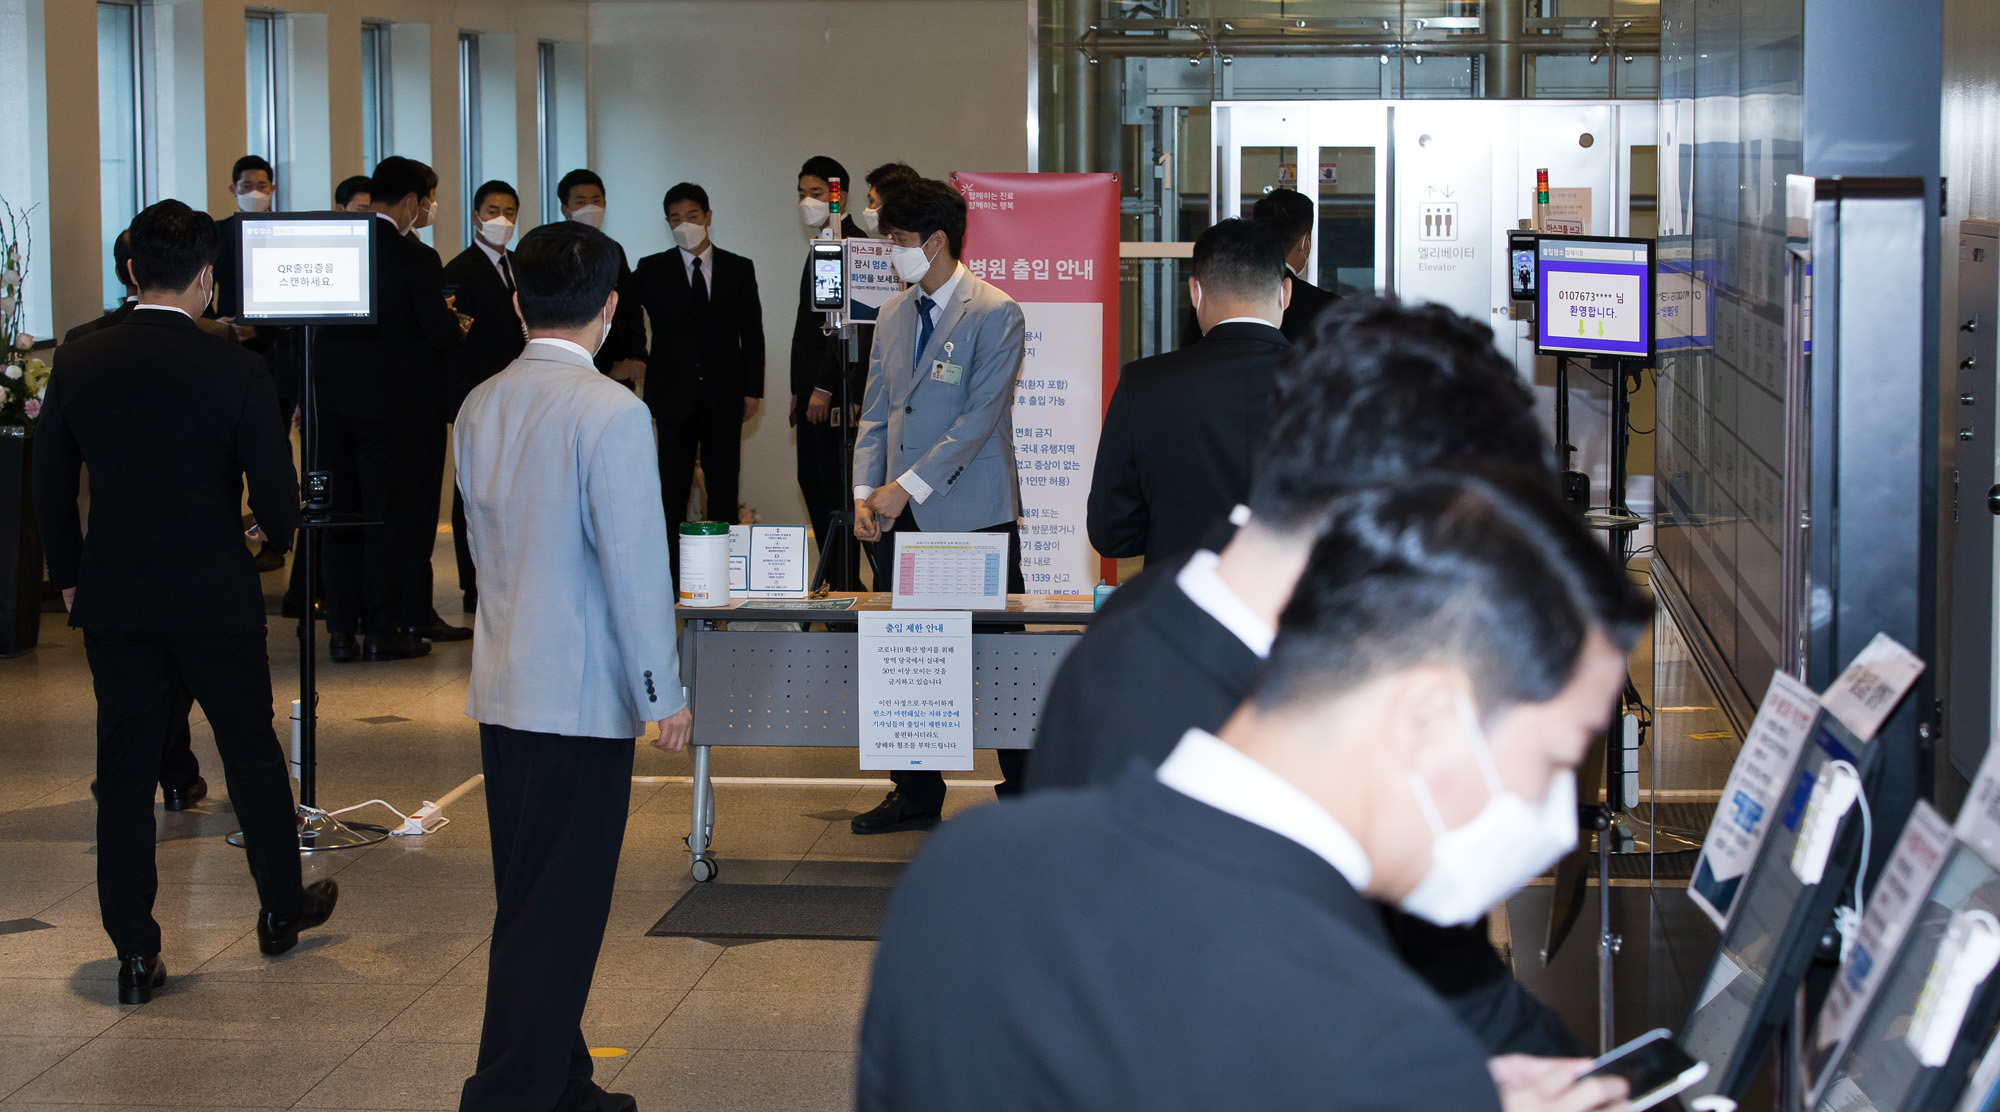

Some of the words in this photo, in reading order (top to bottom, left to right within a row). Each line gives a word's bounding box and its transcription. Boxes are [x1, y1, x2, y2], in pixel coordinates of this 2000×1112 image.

[968, 191, 998, 200] 함께하는
[1000, 191, 1014, 200] 진료
[968, 201, 998, 210] 함께하는
[1000, 201, 1014, 210] 행복
[1546, 224, 1568, 235] 마스크를
[1569, 226, 1580, 234] 쓰고
[851, 246, 883, 256] 마스크를
[885, 248, 892, 256] 쓰
[1418, 247, 1475, 260] 엘리베이터
[277, 263, 334, 274] QR출입증을
[854, 260, 870, 269] 잠시
[872, 261, 888, 270] 멈춘
[969, 258, 1006, 280] 병원
[1012, 258, 1049, 280] 출입
[1055, 259, 1093, 280] 안내
[1418, 263, 1456, 271] Elevator
[279, 277, 334, 287] 스캔하세요.
[851, 274, 875, 283] 화면을
[1616, 292, 1624, 304] 님
[1570, 305, 1617, 319] 환영합니다.
[1047, 380, 1068, 390] 포함)
[1017, 396, 1026, 405] 후
[1029, 396, 1046, 406] 출입
[1048, 396, 1066, 406] 가능
[1015, 428, 1033, 438] 면회
[1035, 428, 1053, 438] 금지
[1020, 444, 1038, 454] 국내
[1040, 444, 1076, 454] 유행지역
[1034, 460, 1061, 471] 증상이
[1063, 460, 1080, 471] 없는
[1026, 477, 1047, 487] 1인만
[1049, 477, 1070, 487] 허용)
[1041, 508, 1059, 519] 또는
[1031, 525, 1075, 535] 방문했거나
[1034, 541, 1060, 551] 증상이
[1034, 557, 1052, 567] 내로
[1031, 573, 1051, 583] 1339
[1053, 573, 1071, 583] 신고
[885, 623, 903, 633] 출입
[905, 623, 923, 633] 제한
[926, 623, 944, 633] 안내
[882, 667, 896, 675] 50인
[897, 667, 910, 675] 이상
[912, 667, 932, 675] 모이는
[934, 667, 947, 675] 것을
[916, 678, 944, 686] 있습니다.
[879, 699, 892, 707] 이런
[893, 699, 919, 707] 사정으로
[921, 699, 954, 707] 부득이하게
[928, 710, 941, 718] 지하
[943, 710, 960, 718] 2층에
[872, 720, 905, 728] 기자님들의
[906, 720, 926, 728] 출입이
[928, 720, 960, 728] 제한되오니
